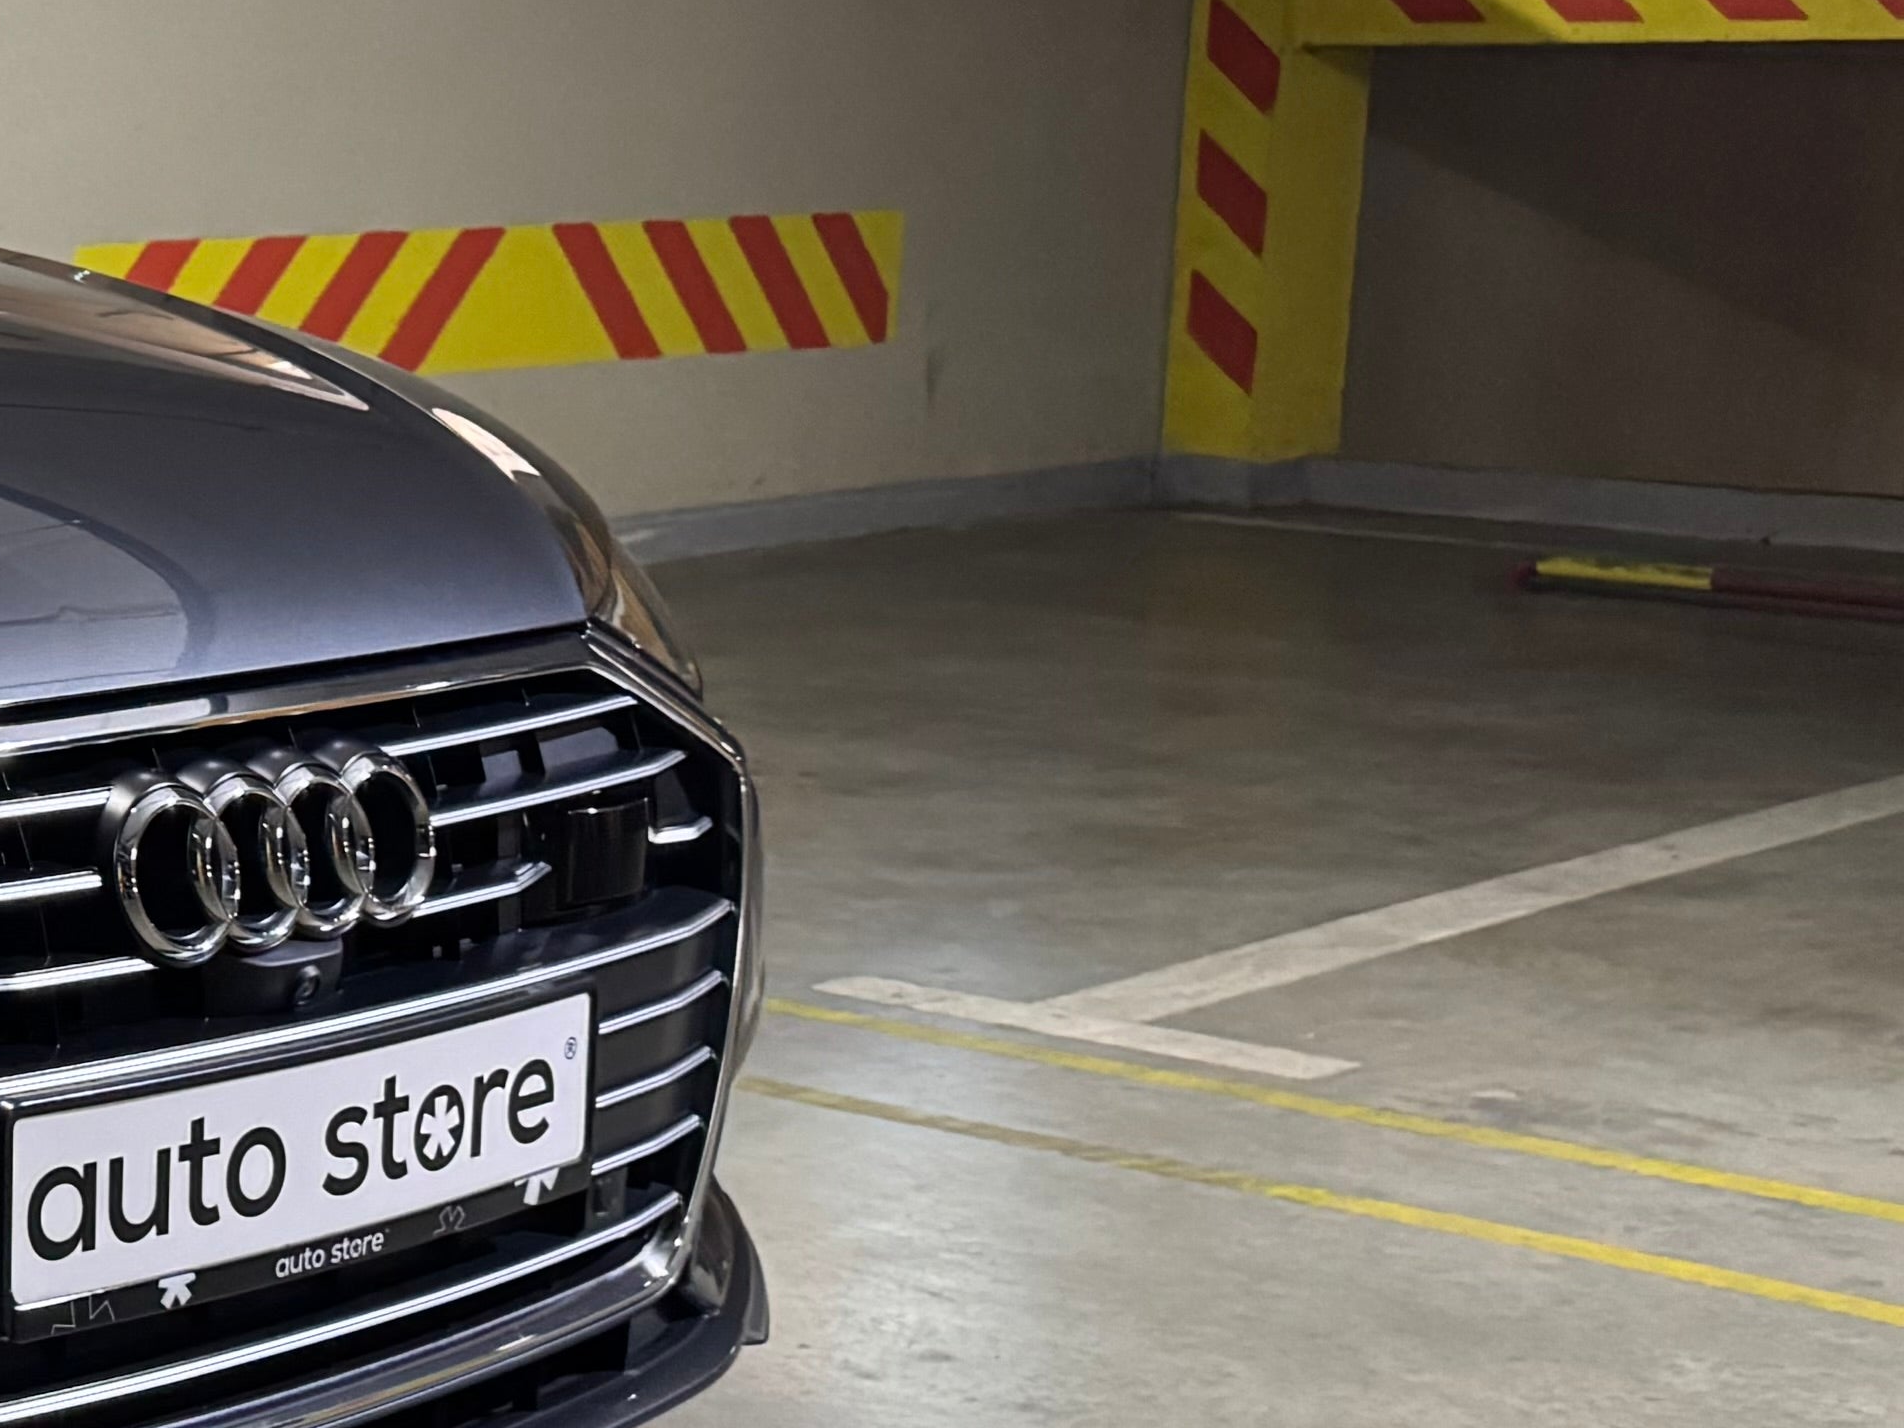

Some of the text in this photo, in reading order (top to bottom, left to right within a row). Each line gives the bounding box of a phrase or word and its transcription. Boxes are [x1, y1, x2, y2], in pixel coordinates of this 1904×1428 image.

[26, 1058, 555, 1262] auto store
[274, 1231, 385, 1278] auto store
